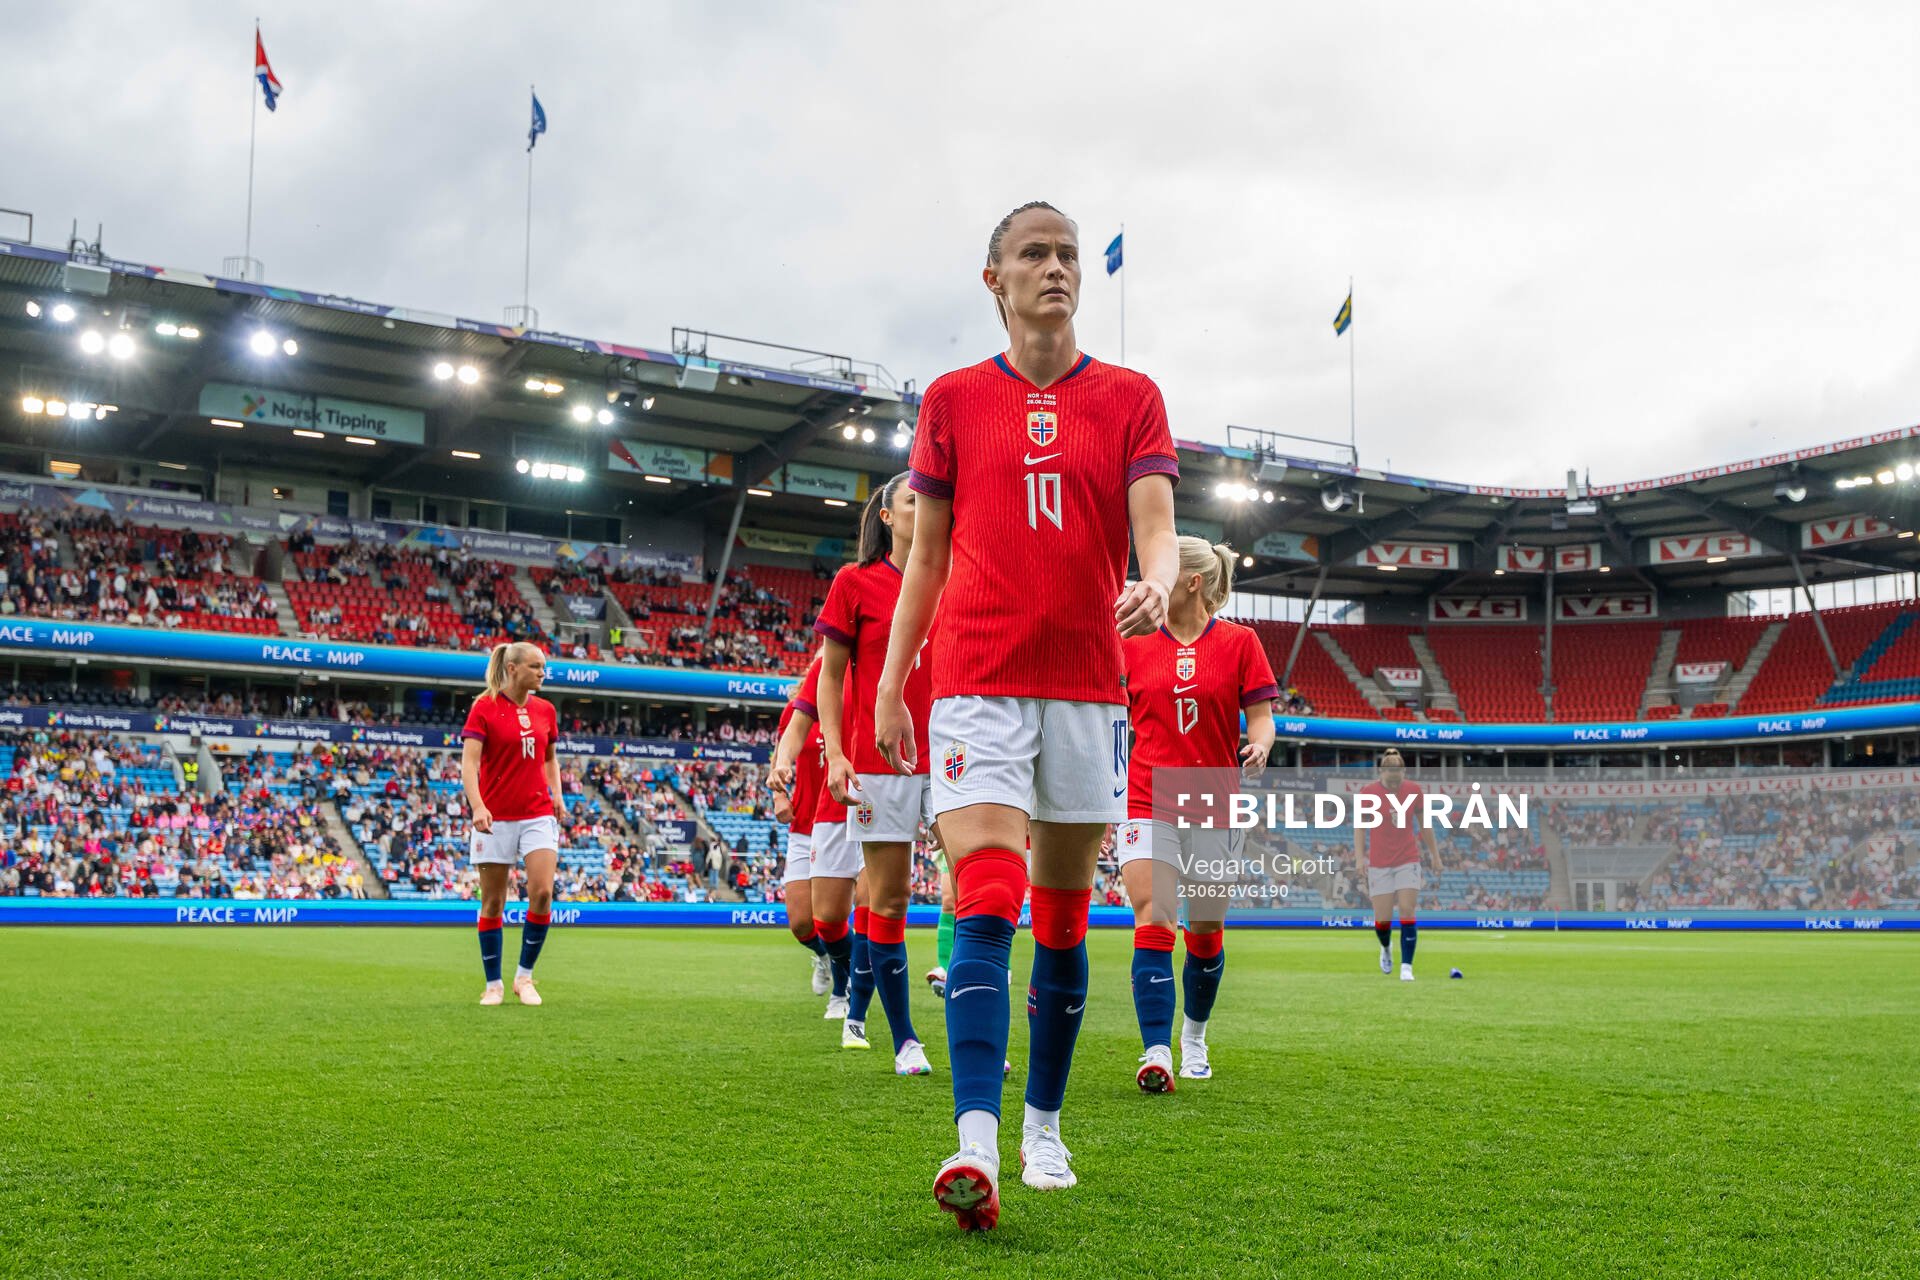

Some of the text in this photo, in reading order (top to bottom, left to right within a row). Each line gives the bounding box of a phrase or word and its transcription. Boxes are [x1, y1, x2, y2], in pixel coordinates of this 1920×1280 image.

[272, 402, 387, 435] Norsk Tipping
[143, 502, 214, 521] Norsk Tipping
[1024, 473, 1062, 531] 10
[321, 521, 387, 540] Norsk Tipping
[1810, 517, 1891, 546] VG
[1366, 545, 1448, 565] VG
[1661, 535, 1750, 560] VG
[1508, 547, 1590, 571] VG
[1435, 599, 1522, 619] VG
[1560, 596, 1653, 617] VG
[0, 626, 33, 642] ACE
[262, 645, 312, 662] PEACE
[728, 680, 767, 695] PEACE
[65, 714, 131, 729] Norsk Tipping
[1175, 698, 1198, 735] 13
[171, 720, 234, 734] Norsk Tipping
[271, 725, 330, 739] Norsk Tipping
[366, 730, 424, 744] Norsk Tipping
[521, 736, 535, 760] 18
[567, 741, 595, 754] Tipping
[626, 744, 676, 757] Norsk Tipping
[705, 748, 752, 761] Norsk Tipping
[1112, 720, 1127, 777] 10
[177, 906, 235, 923] PEACE
[732, 910, 776, 924] PEACE
